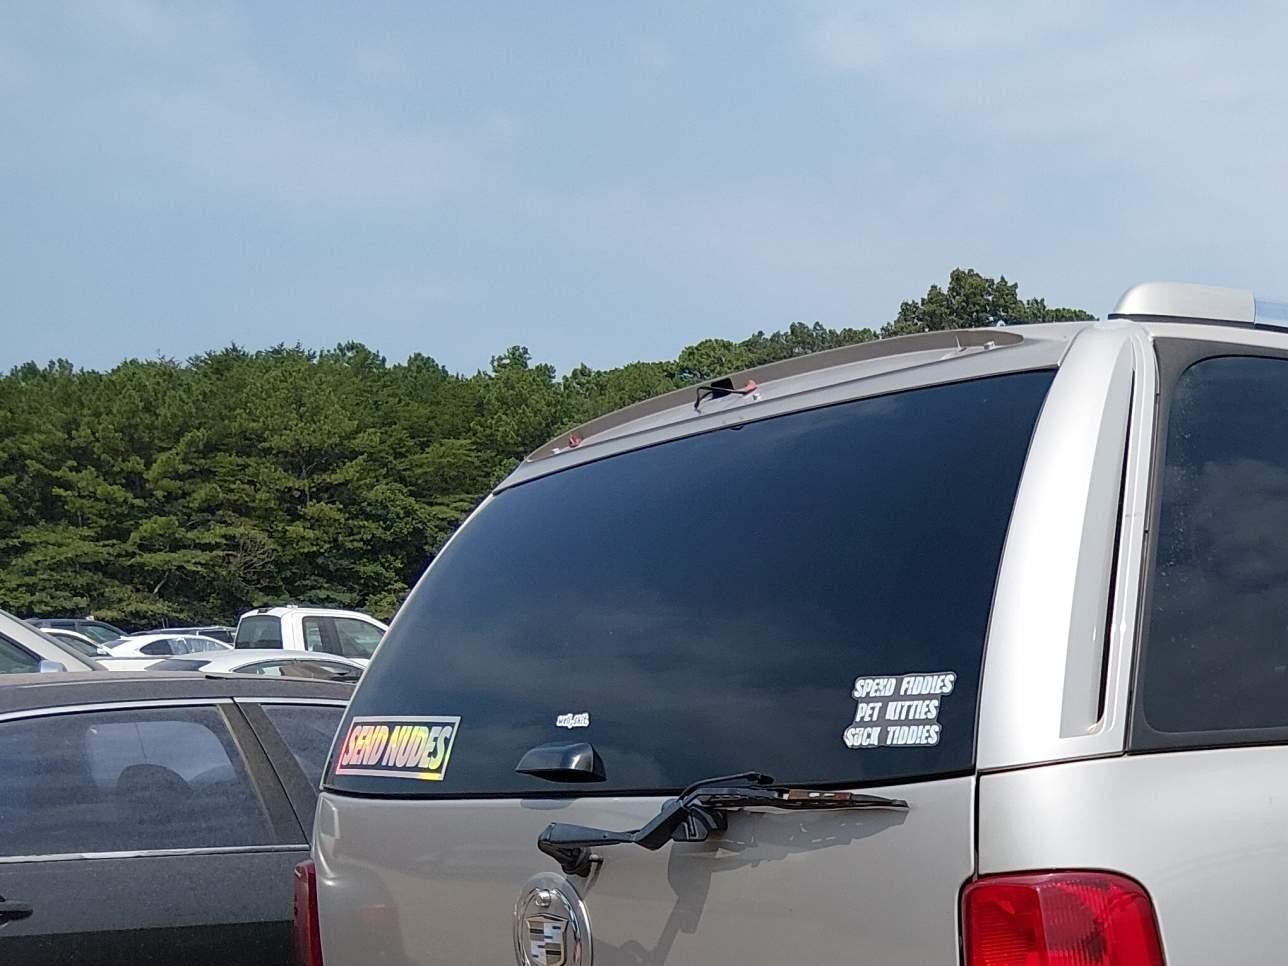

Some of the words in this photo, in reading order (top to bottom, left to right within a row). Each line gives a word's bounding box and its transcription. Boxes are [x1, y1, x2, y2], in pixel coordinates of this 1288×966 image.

[900, 674, 955, 696] FIDDIES
[855, 702, 882, 722] PET
[885, 699, 939, 720] KITTIES
[846, 726, 881, 746] SUCK
[886, 724, 940, 745] TIDDIES
[341, 725, 390, 766] SEND
[381, 725, 453, 770] NUDES
